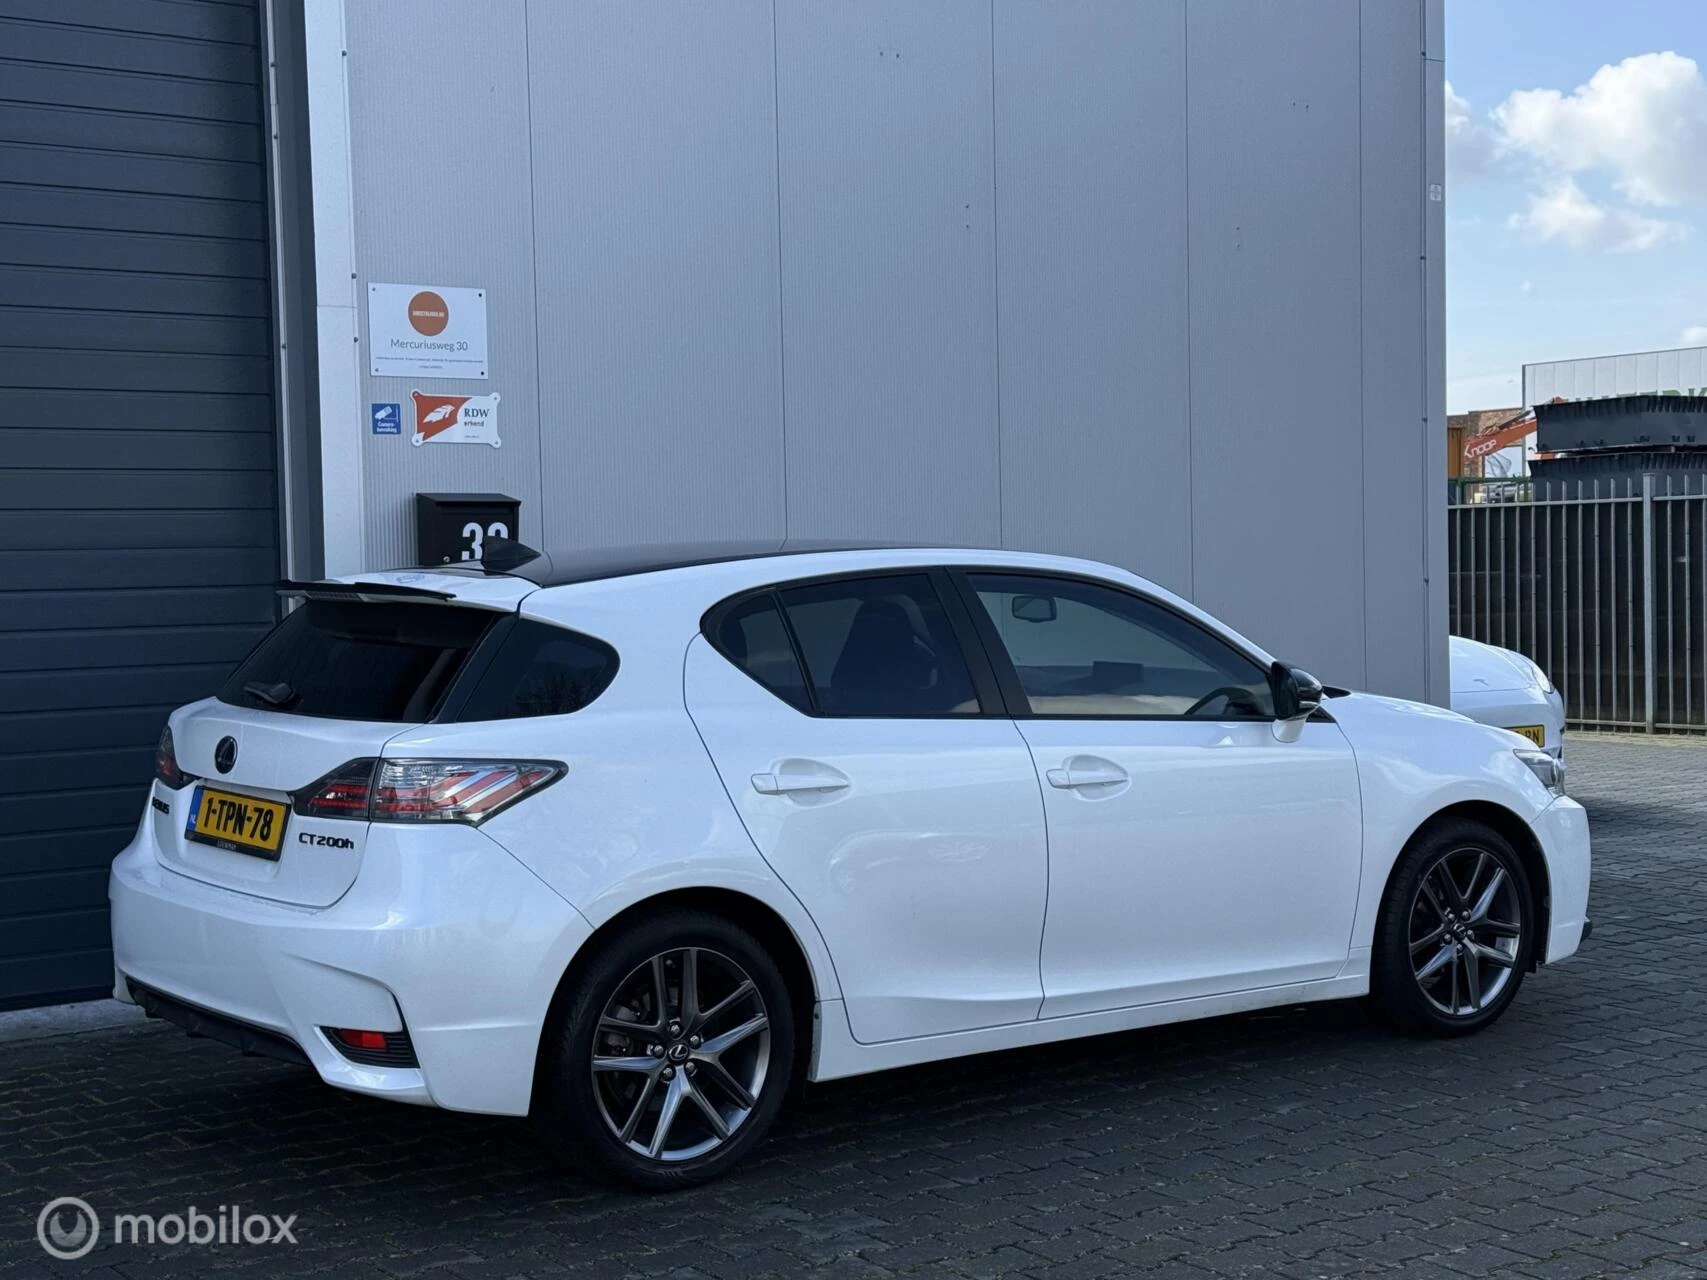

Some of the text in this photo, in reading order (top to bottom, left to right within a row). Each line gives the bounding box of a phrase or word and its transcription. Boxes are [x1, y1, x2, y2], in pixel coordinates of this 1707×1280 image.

[390, 338, 469, 352] Mercuriusweg 30
[464, 408, 490, 418] RDW
[203, 797, 275, 841] 1-TPN-78
[298, 832, 355, 850] CT200h
